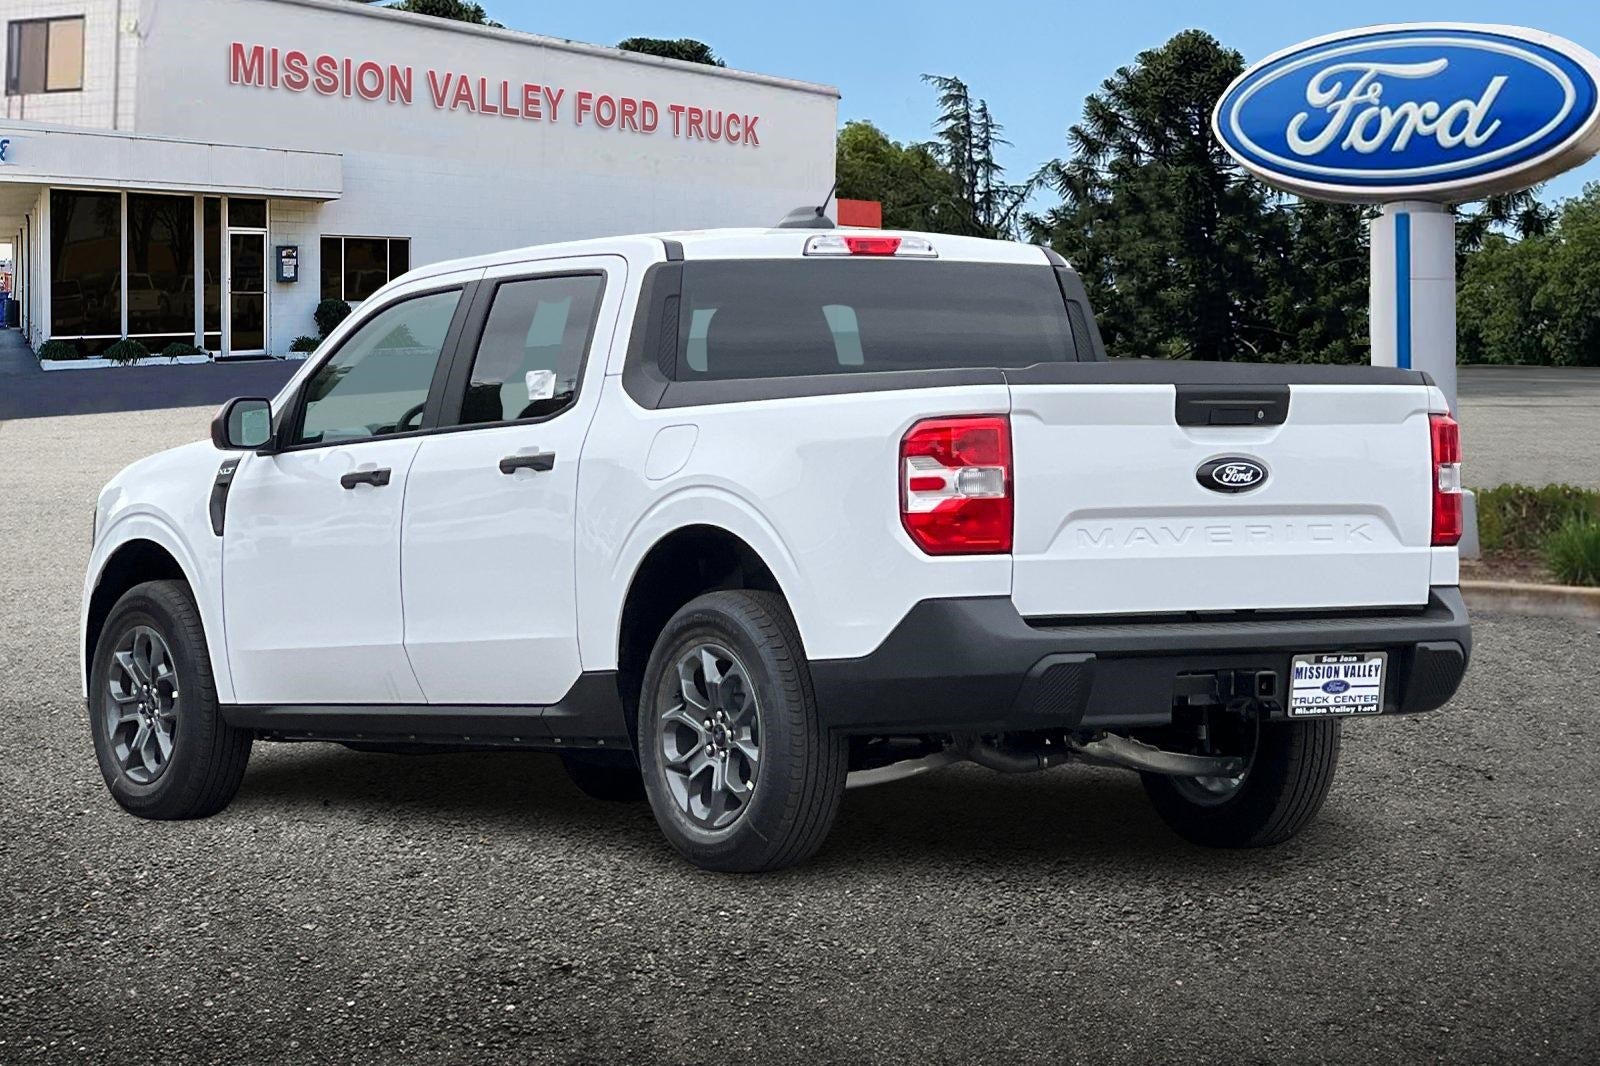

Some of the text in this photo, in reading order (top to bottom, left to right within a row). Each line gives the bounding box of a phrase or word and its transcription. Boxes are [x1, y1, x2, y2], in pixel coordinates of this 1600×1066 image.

[229, 41, 761, 147] MISSION VALLEY FORD TRUCK
[1286, 57, 1509, 157] Ford
[1222, 465, 1254, 483] Ford
[1076, 522, 1375, 549] MAVERICK
[1294, 664, 1381, 679] MISSION VALLEY
[1326, 681, 1346, 692] Ford
[1293, 694, 1378, 705] TRUCK CENTER
[1329, 706, 1358, 714] Valley
